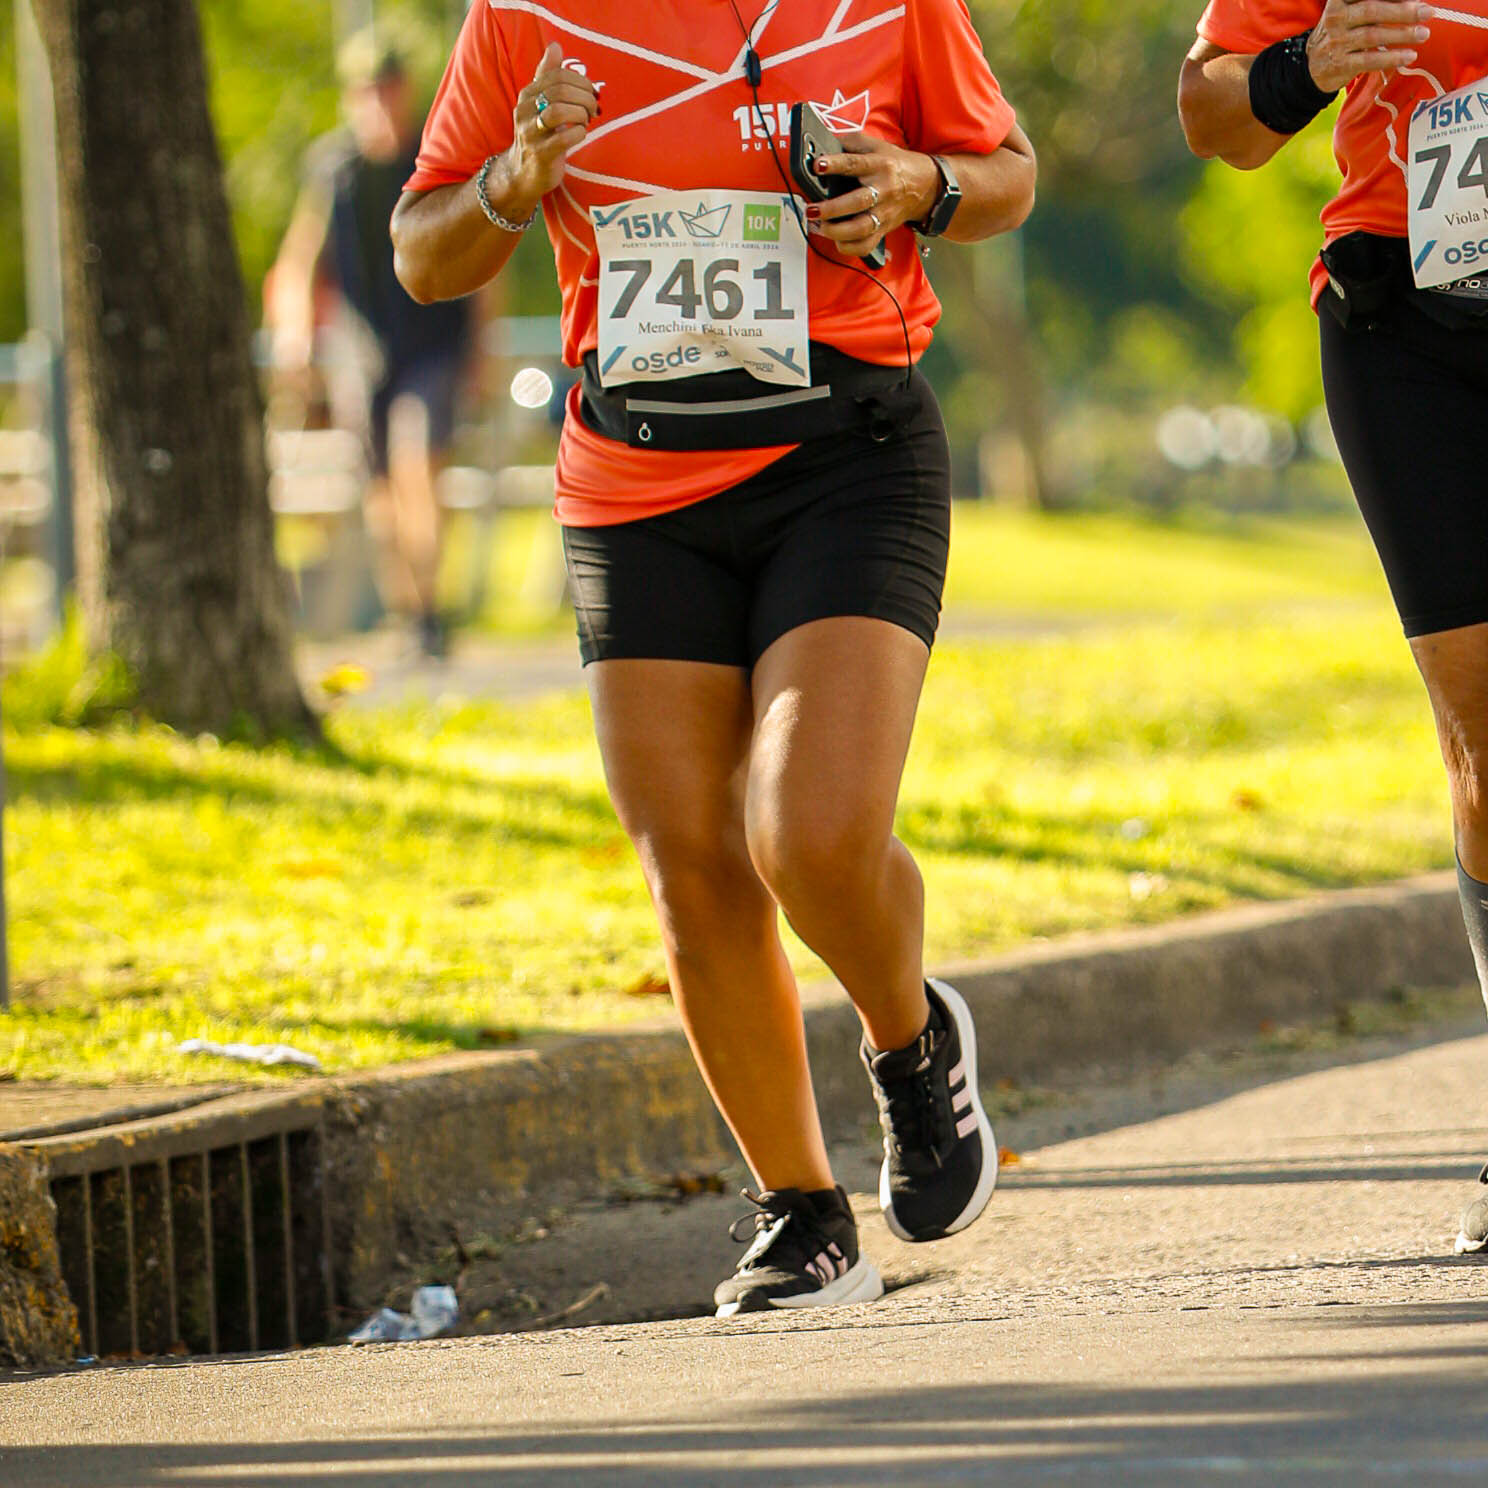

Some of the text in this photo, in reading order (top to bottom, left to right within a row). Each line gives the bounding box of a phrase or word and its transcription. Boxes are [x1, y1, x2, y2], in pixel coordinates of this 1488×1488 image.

[1428, 94, 1474, 129] 15K
[741, 140, 787, 152] PUER
[617, 211, 677, 239] 15K
[747, 215, 777, 231] 10K
[1444, 209, 1480, 227] Viola
[608, 258, 795, 320] 7461
[638, 320, 697, 335] Menchini
[728, 326, 763, 338] Ivana
[632, 345, 702, 373] osde
